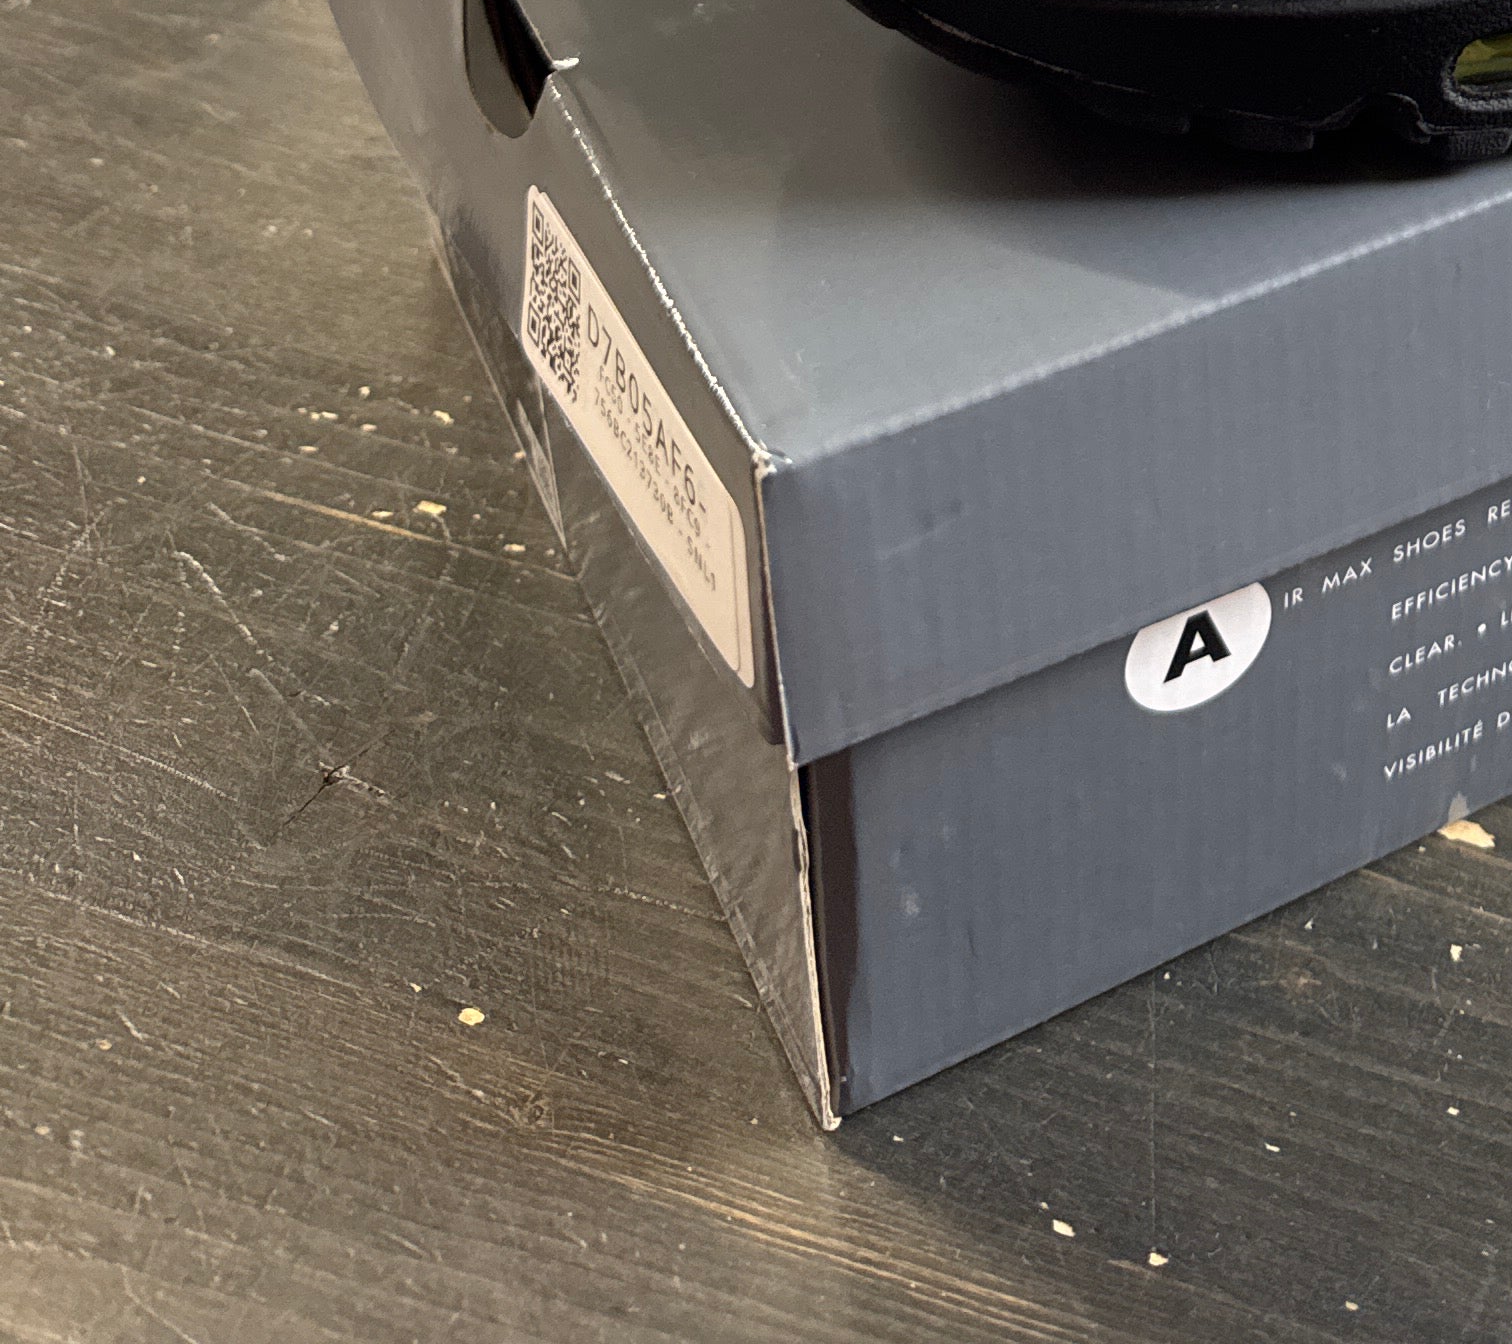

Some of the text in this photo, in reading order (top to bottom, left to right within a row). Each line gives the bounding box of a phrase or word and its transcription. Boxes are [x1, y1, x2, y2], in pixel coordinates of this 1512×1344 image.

[1163, 610, 1231, 683] A
[1321, 557, 1372, 594] MAX
[1393, 517, 1466, 563] SHOES
[1388, 633, 1462, 677] CLEAR.
[1386, 703, 1411, 729] LA
[1383, 717, 1483, 781] VISIBILITÉ
